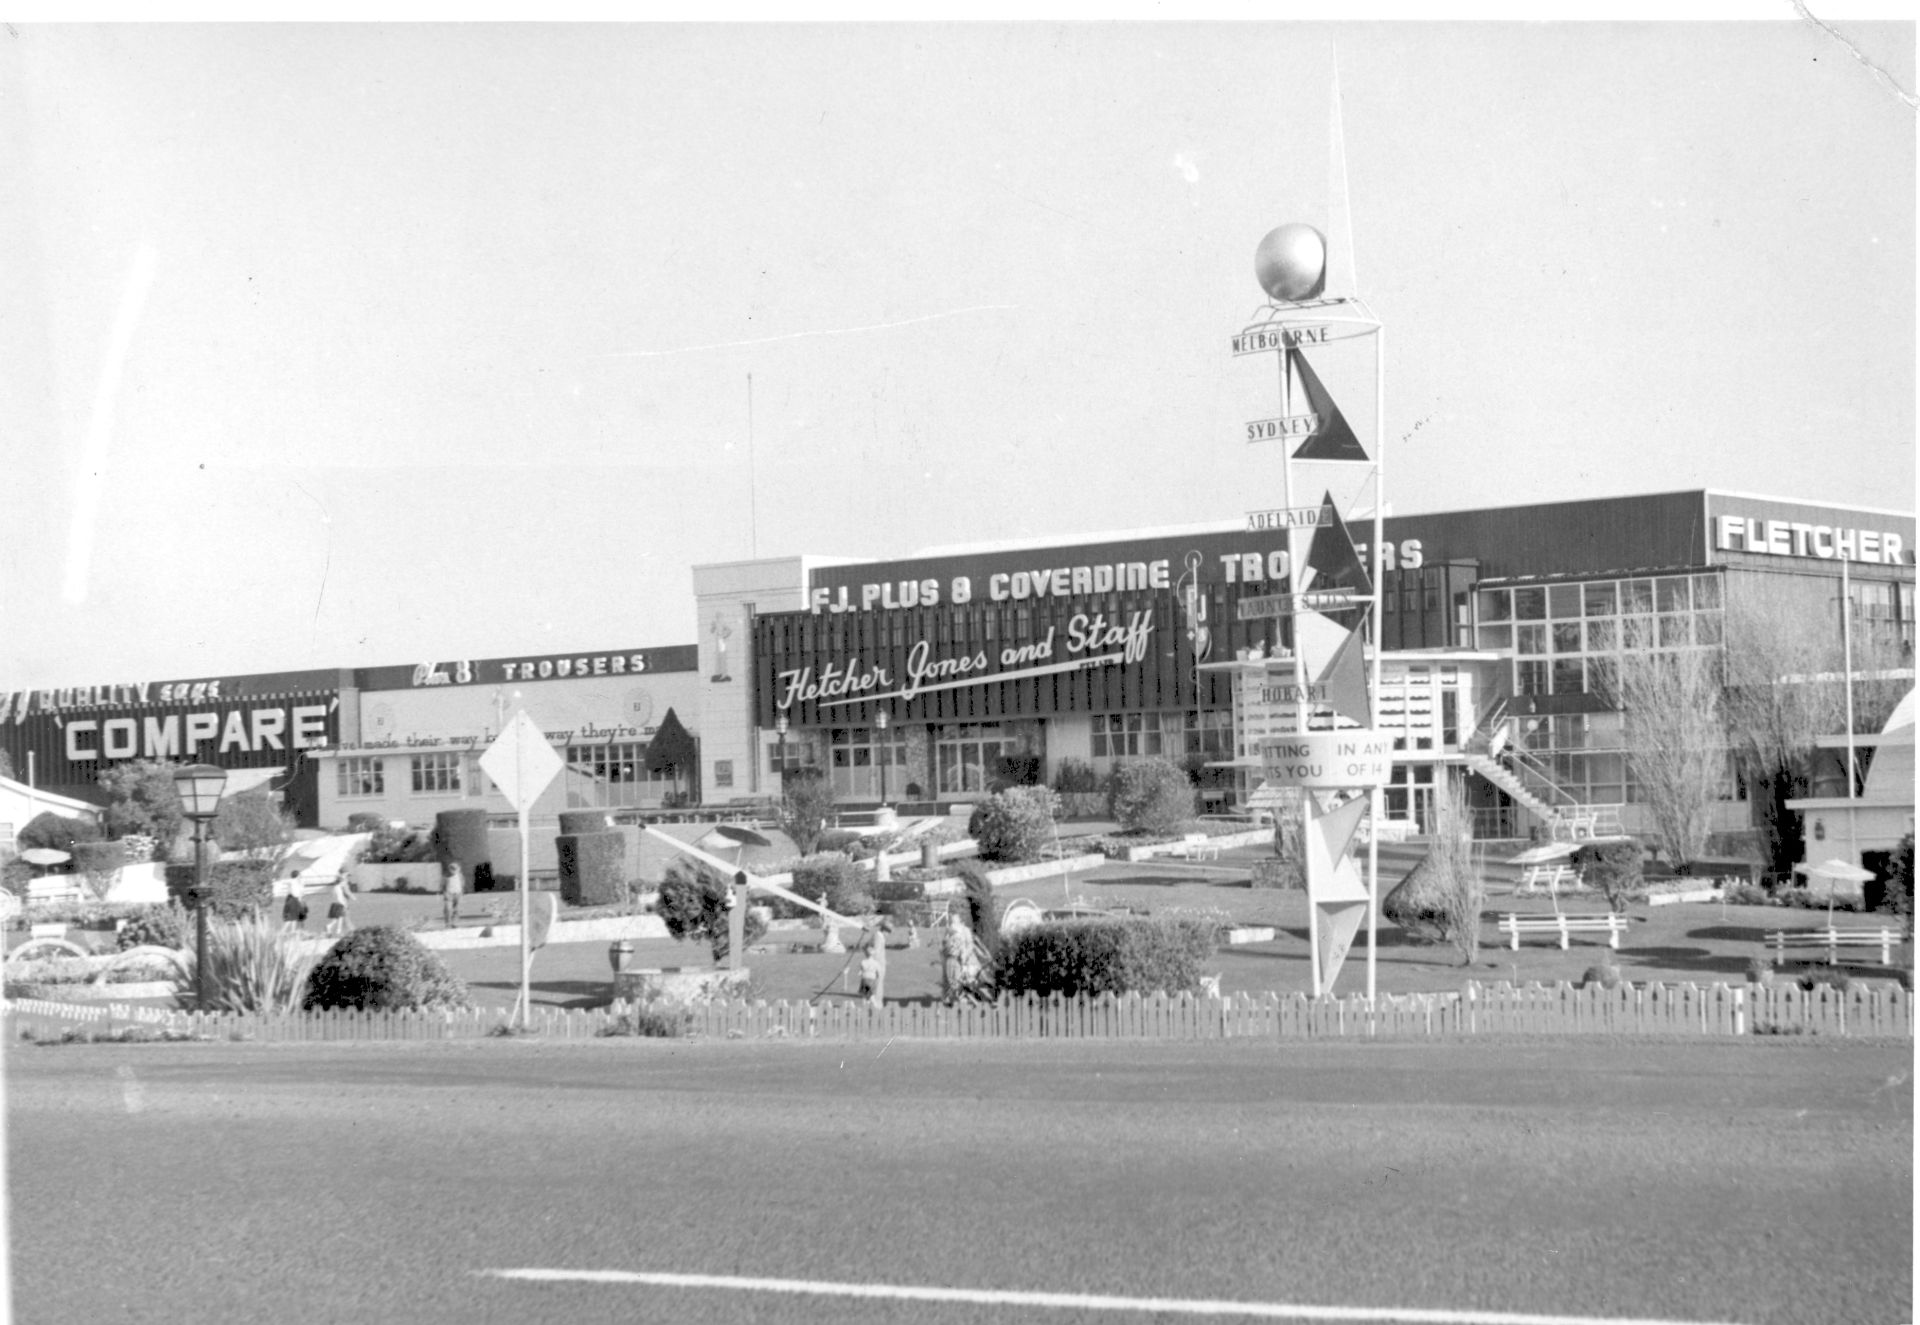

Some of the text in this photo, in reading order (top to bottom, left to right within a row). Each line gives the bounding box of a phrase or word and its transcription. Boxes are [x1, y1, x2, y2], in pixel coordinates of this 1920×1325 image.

[1247, 418, 1313, 440] SYDNEY
[1717, 515, 1903, 565] FLETCHER
[862, 578, 939, 609] PLUS
[951, 576, 972, 604] 8
[990, 559, 1171, 602] COVERDINE
[456, 659, 472, 684] 8
[502, 654, 646, 681] TROUSERS
[777, 609, 1154, 709] Fletcher Jones and Staff
[40, 682, 151, 710] QUALITY
[1262, 685, 1328, 703] HOBART
[364, 733, 399, 748] made
[407, 732, 441, 747] their
[450, 735, 479, 751] way
[543, 730, 575, 746] way
[1337, 743, 1357, 757] IN
[1285, 764, 1324, 779] YOU
[1346, 763, 1367, 777] OF
